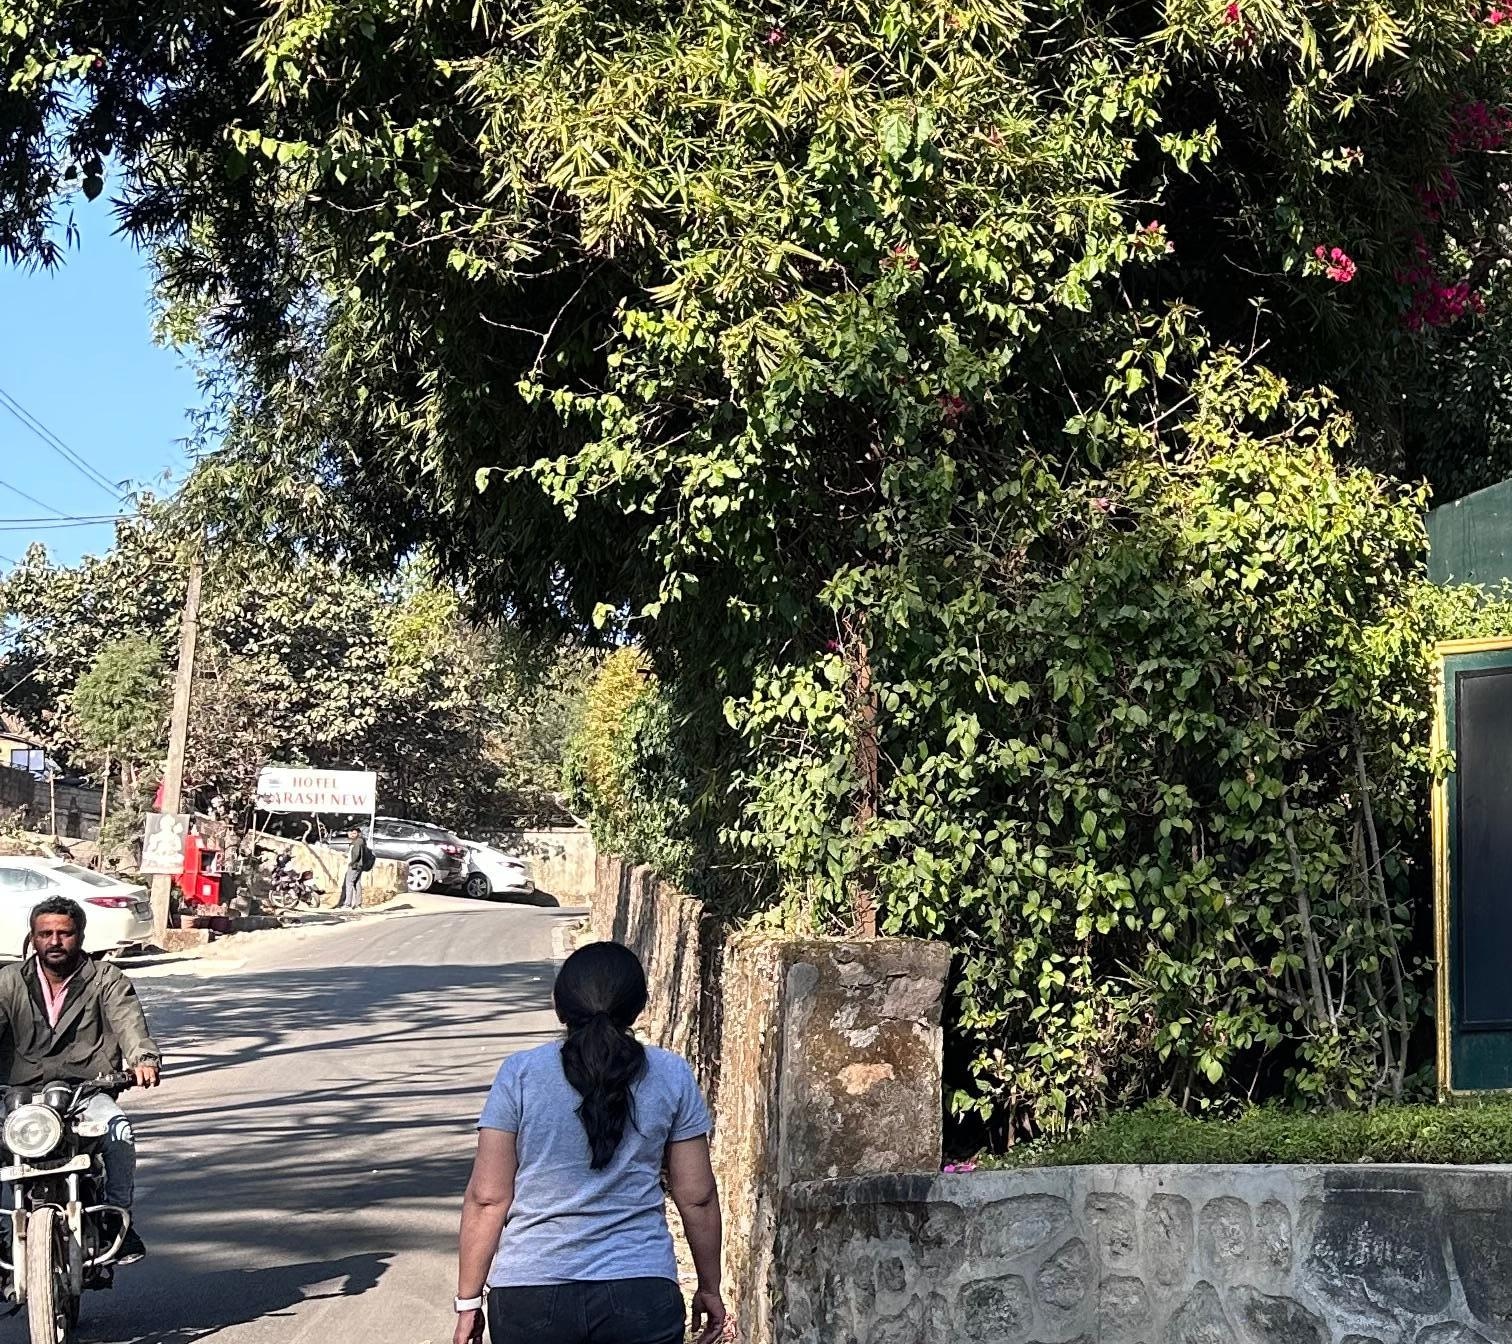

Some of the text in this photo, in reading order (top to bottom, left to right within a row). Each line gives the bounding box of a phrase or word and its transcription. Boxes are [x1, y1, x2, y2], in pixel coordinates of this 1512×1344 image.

[292, 776, 337, 789] HOTEL
[261, 791, 367, 806] ARASH NEW
